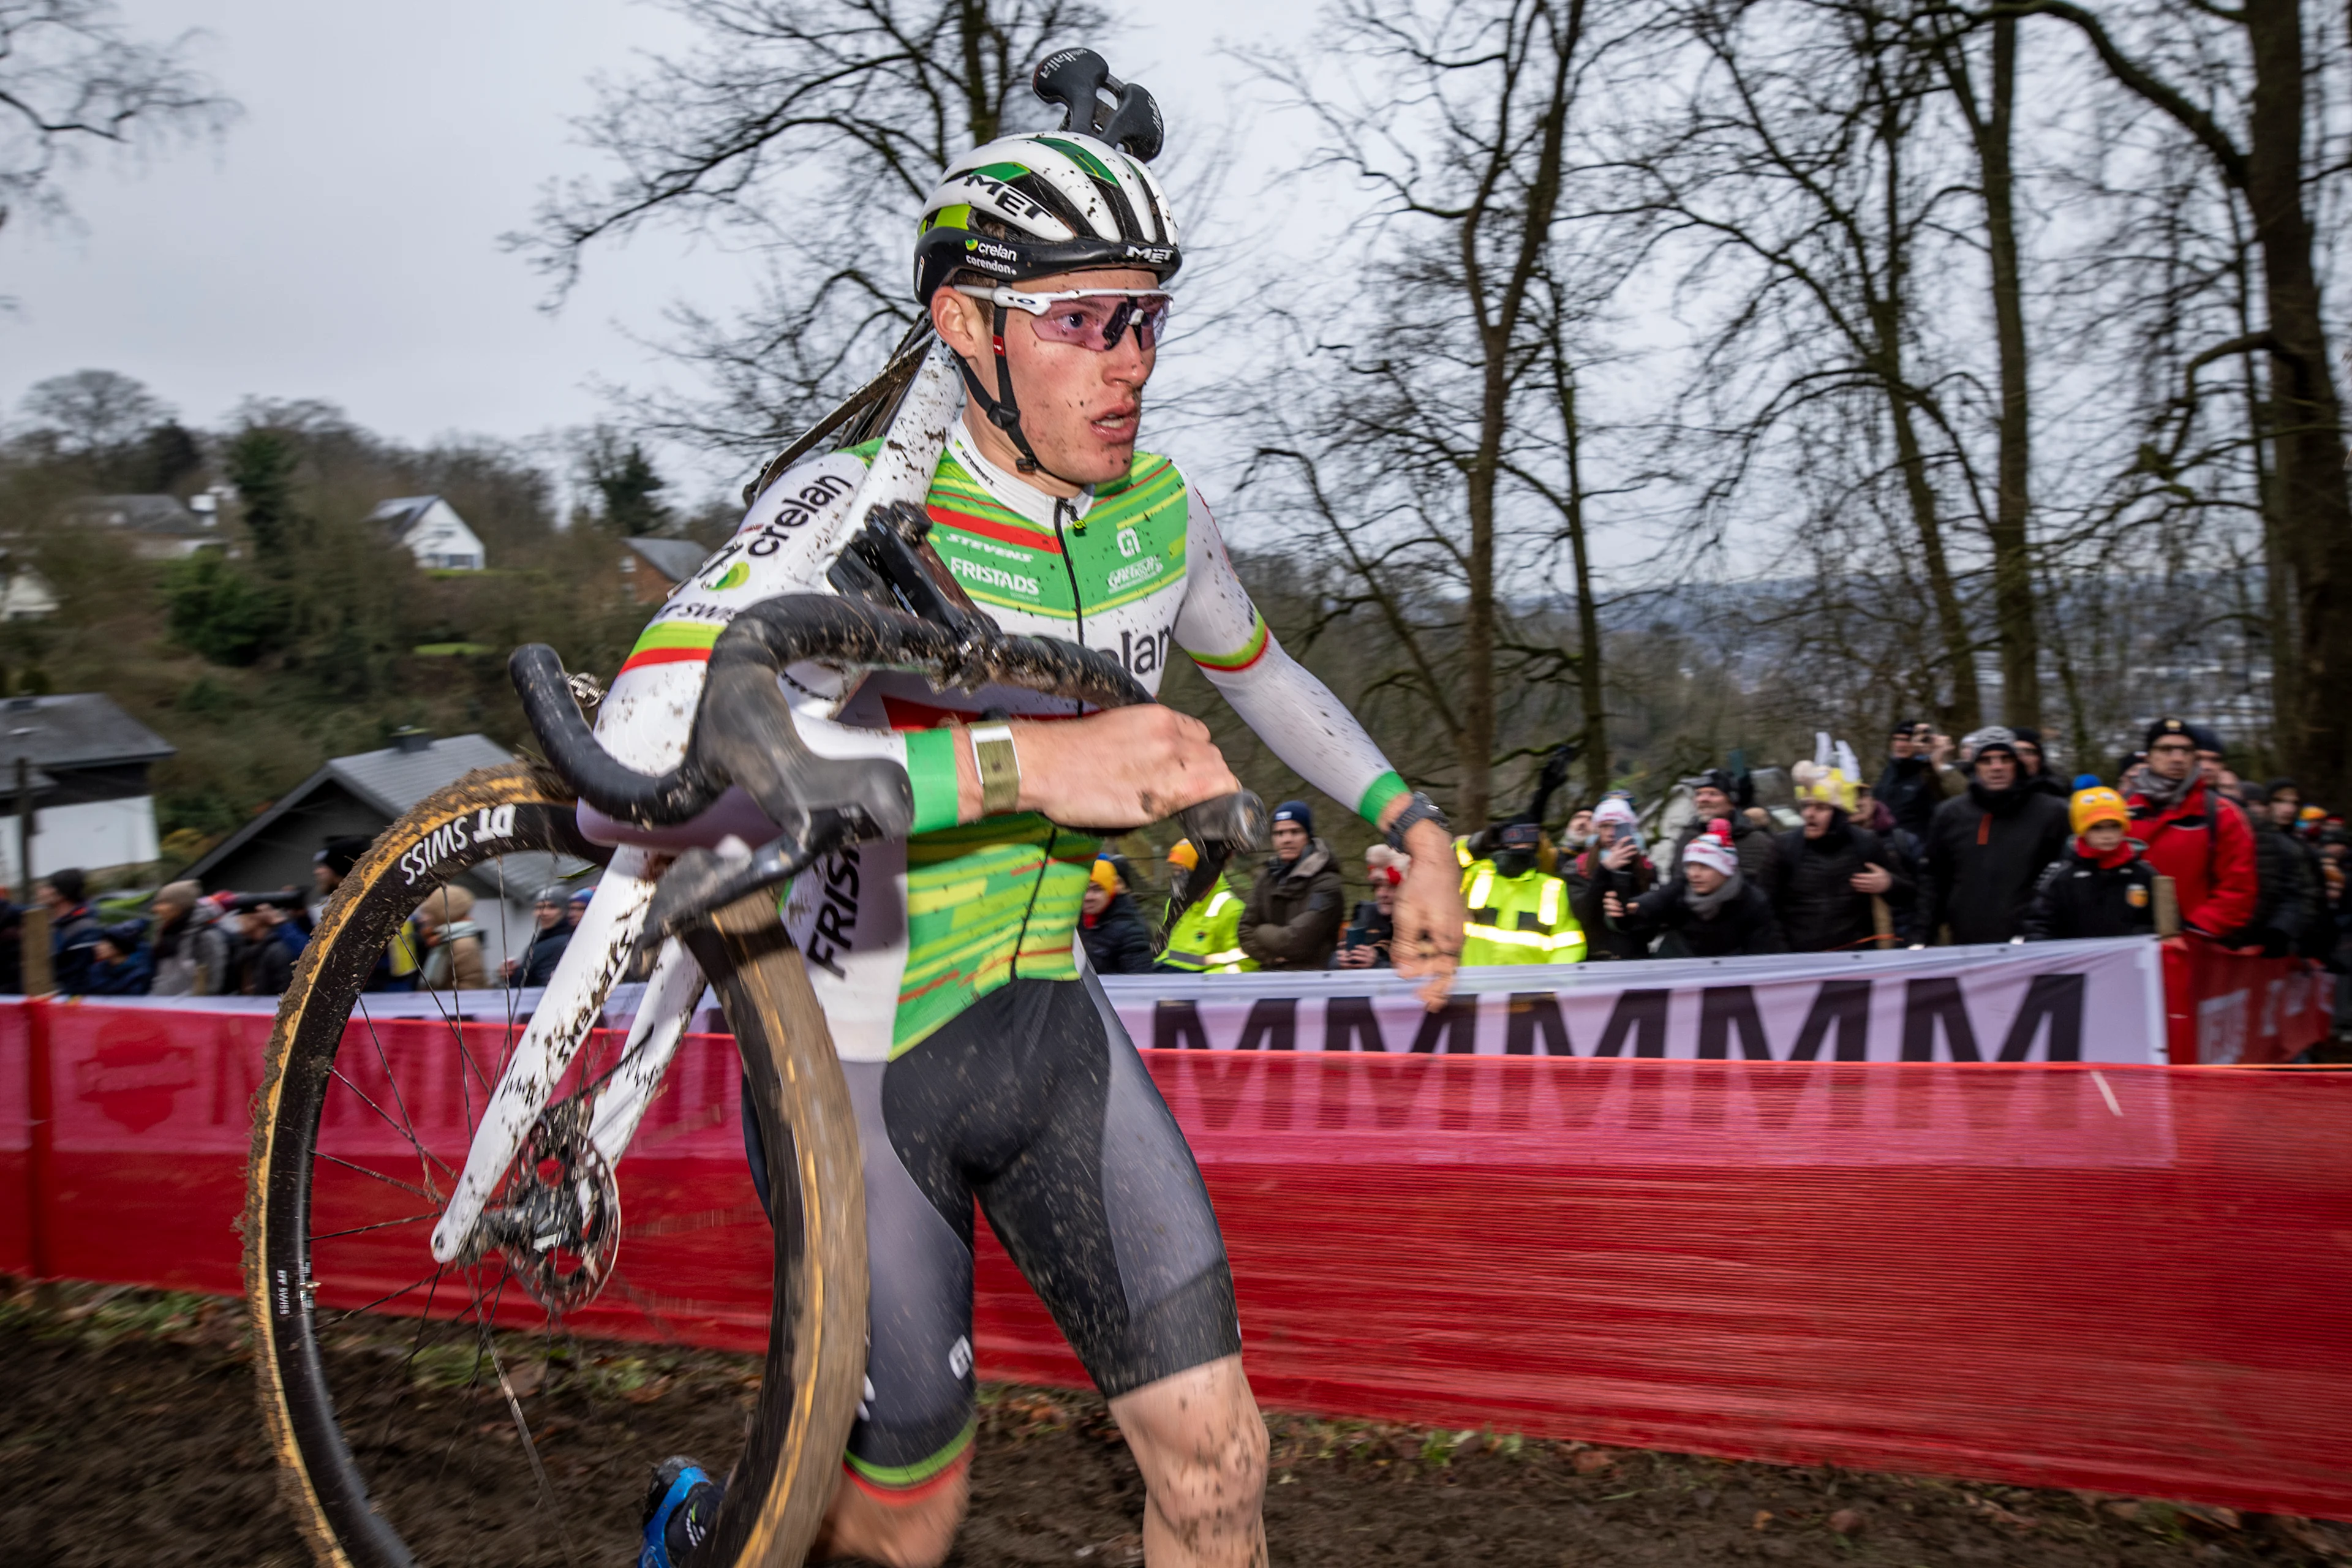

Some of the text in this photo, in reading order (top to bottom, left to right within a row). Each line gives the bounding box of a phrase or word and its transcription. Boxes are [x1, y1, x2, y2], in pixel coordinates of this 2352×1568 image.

[963, 174, 1053, 221] MET
[978, 242, 1017, 262] crelan
[1126, 245, 1174, 264] MET
[747, 475, 854, 557] crelan
[945, 533, 1035, 564] STEVENS
[951, 556, 1040, 596] FRISTADS
[400, 802, 517, 886] DT SWISS
[806, 848, 861, 980] FRIS
